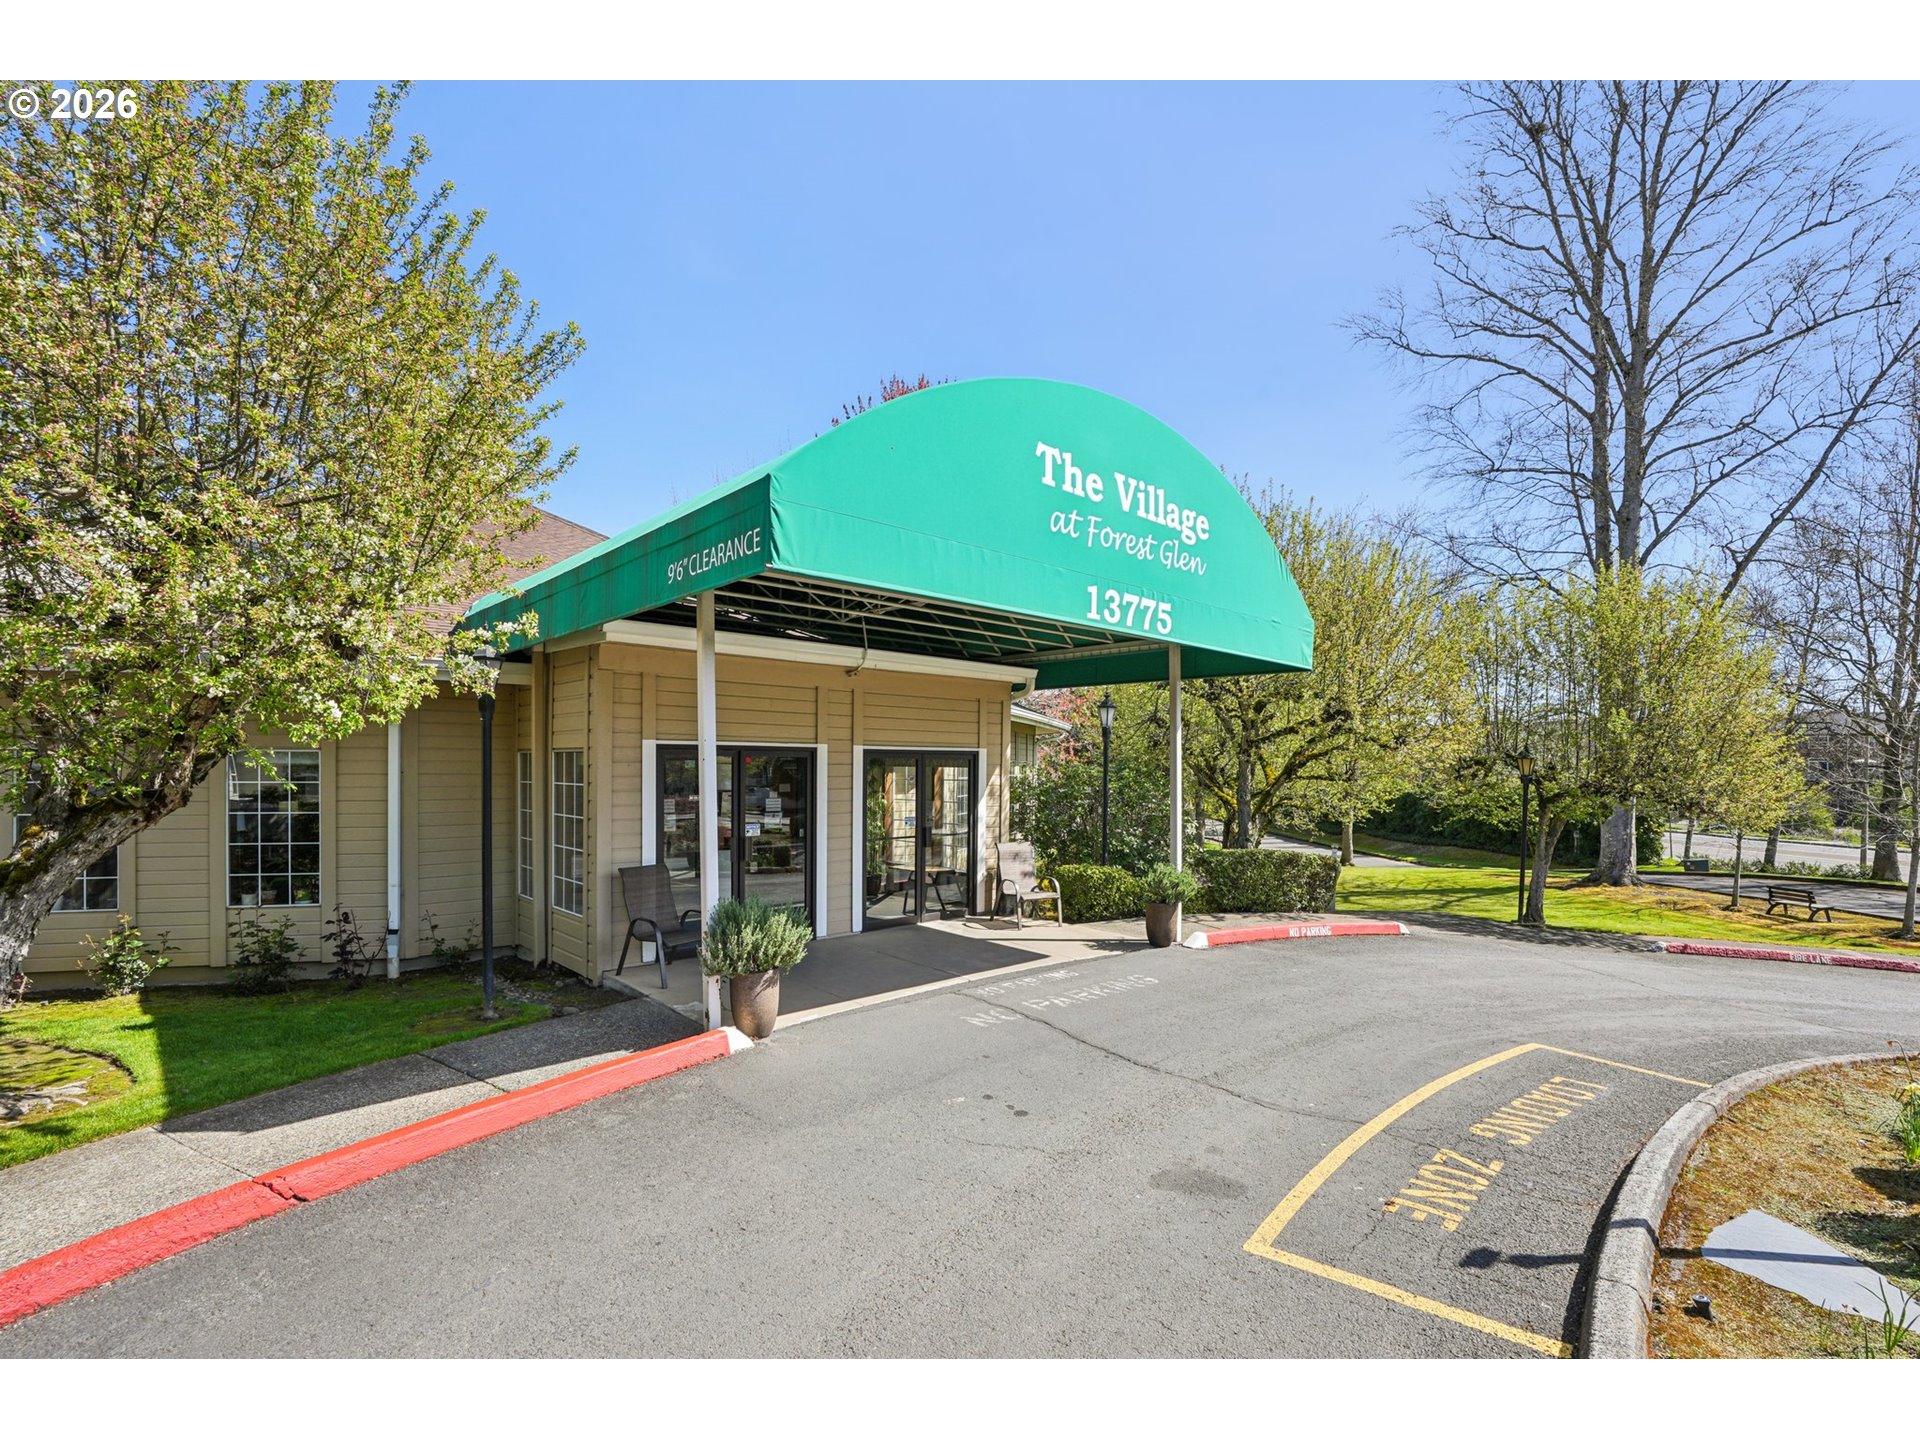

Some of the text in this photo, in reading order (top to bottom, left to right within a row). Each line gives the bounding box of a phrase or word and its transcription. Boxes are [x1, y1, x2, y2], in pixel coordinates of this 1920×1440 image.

[1035, 440, 1210, 545] The Village
[688, 527, 761, 576] CLEARANCE
[1050, 509, 1207, 576] at Forest Glen
[1087, 585, 1172, 635] 13775
[1289, 926, 1332, 937] NO PARKING
[1022, 974, 1159, 1011] PARKING
[1383, 1076, 1607, 1232] LOADING ZONE
